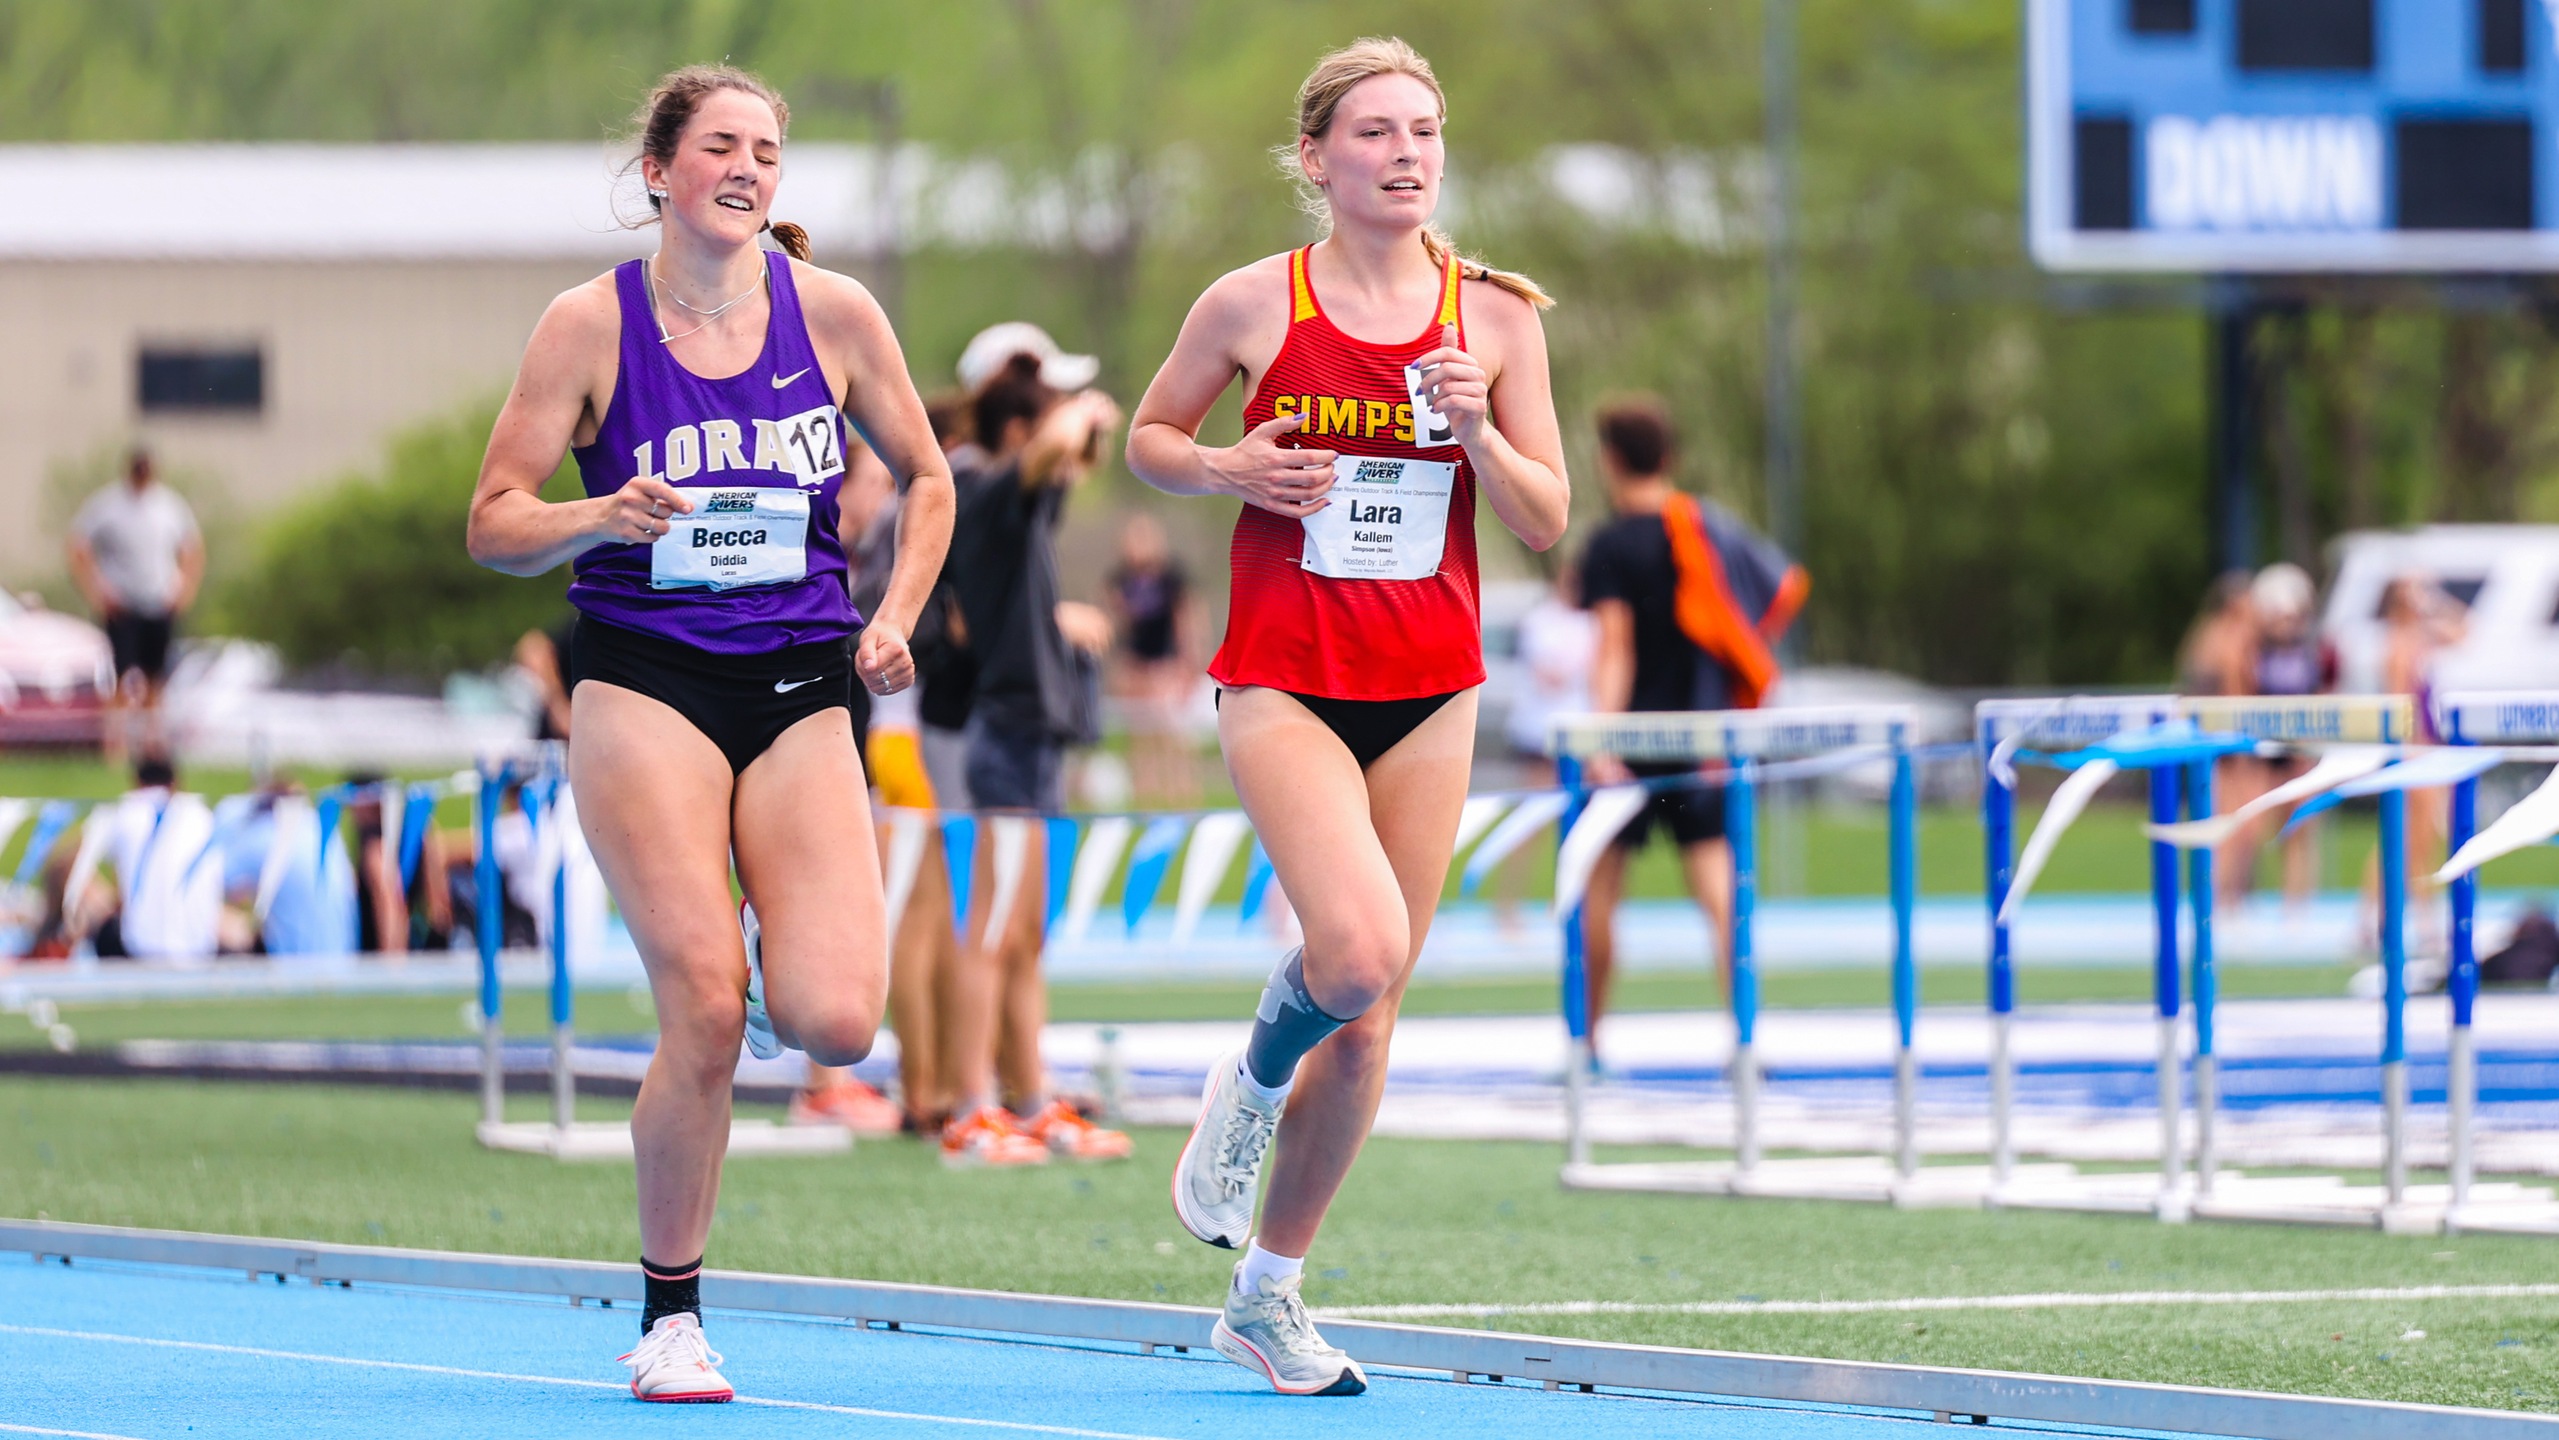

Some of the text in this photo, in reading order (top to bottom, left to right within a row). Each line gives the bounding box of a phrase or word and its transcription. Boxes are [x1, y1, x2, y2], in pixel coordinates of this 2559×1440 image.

[2148, 114, 2386, 229] DOWN
[1273, 394, 1416, 443] SIMPS
[633, 418, 800, 483] LORA
[789, 415, 838, 474] 12
[1358, 460, 1406, 469] AMERICAN
[711, 491, 759, 500] AMERICAN
[1350, 499, 1402, 524] Lara
[692, 526, 767, 548] Becca
[1354, 530, 1393, 543] Kallem
[710, 554, 748, 567] Diddia
[1343, 557, 1367, 566] Hosted
[1378, 558, 1399, 567] Luther
